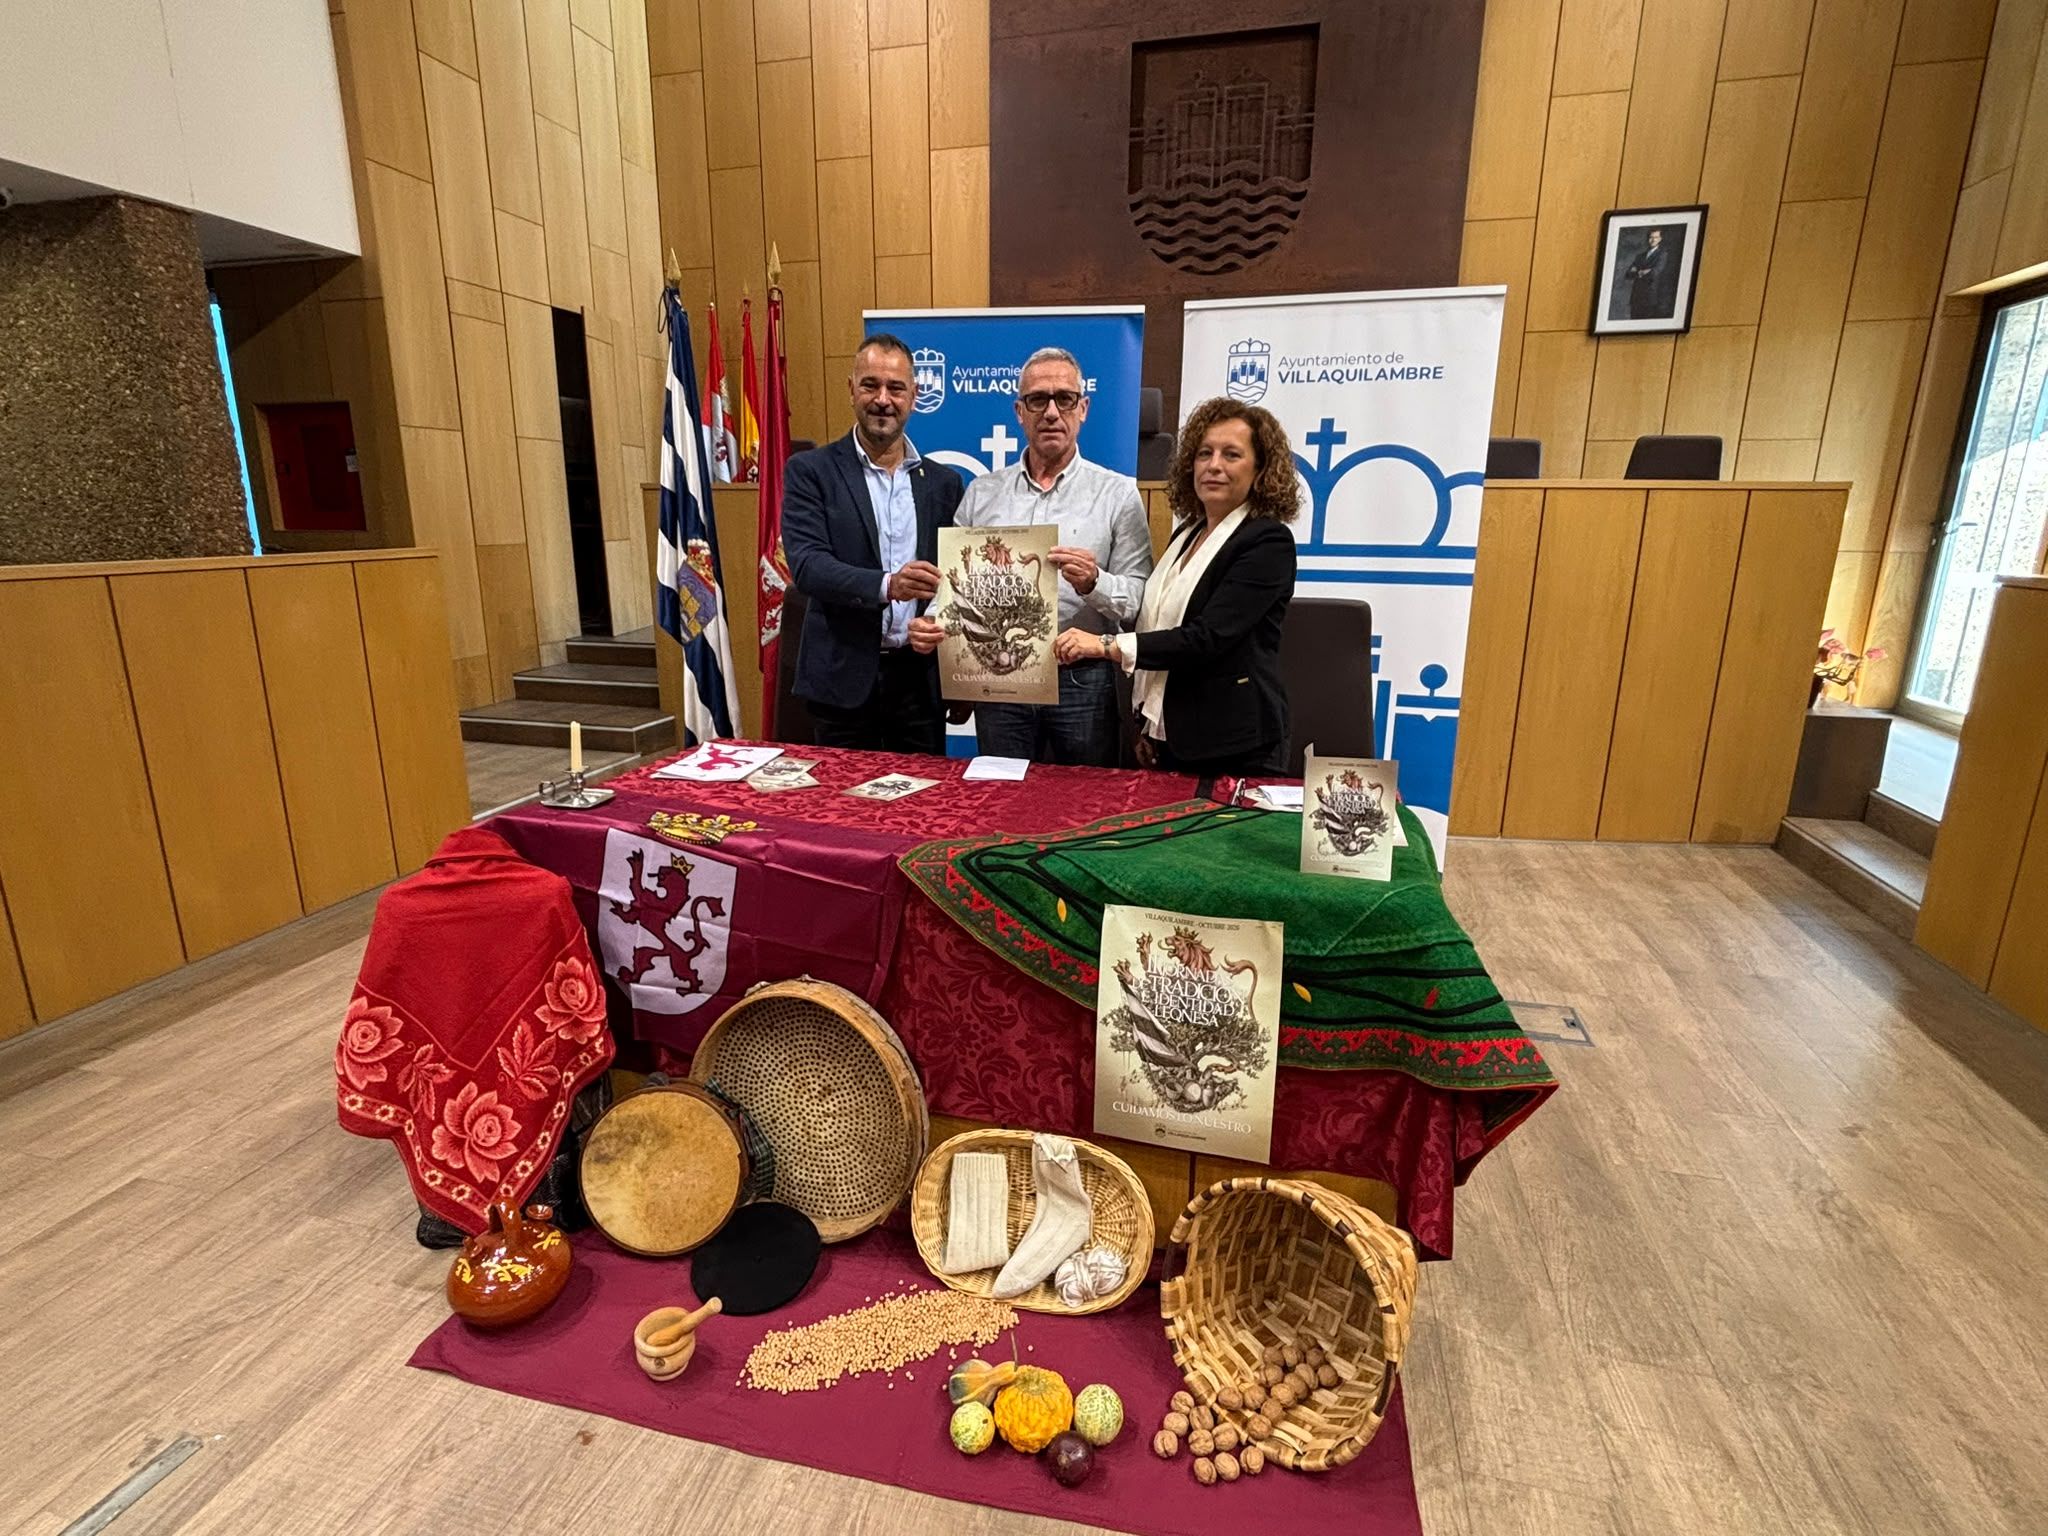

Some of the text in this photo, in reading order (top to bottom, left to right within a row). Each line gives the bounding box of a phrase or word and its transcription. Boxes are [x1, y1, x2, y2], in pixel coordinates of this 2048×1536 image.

[1278, 351, 1404, 369] Ayuntamiento de
[952, 365, 1020, 379] Ayuntamie
[1278, 364, 1444, 384] VILLAQUILAMBRE
[1145, 912, 1194, 927] VILLAQUILAMBRE
[1154, 990, 1235, 1017] IDENTIDAD
[1154, 1004, 1219, 1027] LEONESA
[1112, 1100, 1175, 1121] CUIDAMOS
[1194, 1114, 1252, 1135] NUESTRO
